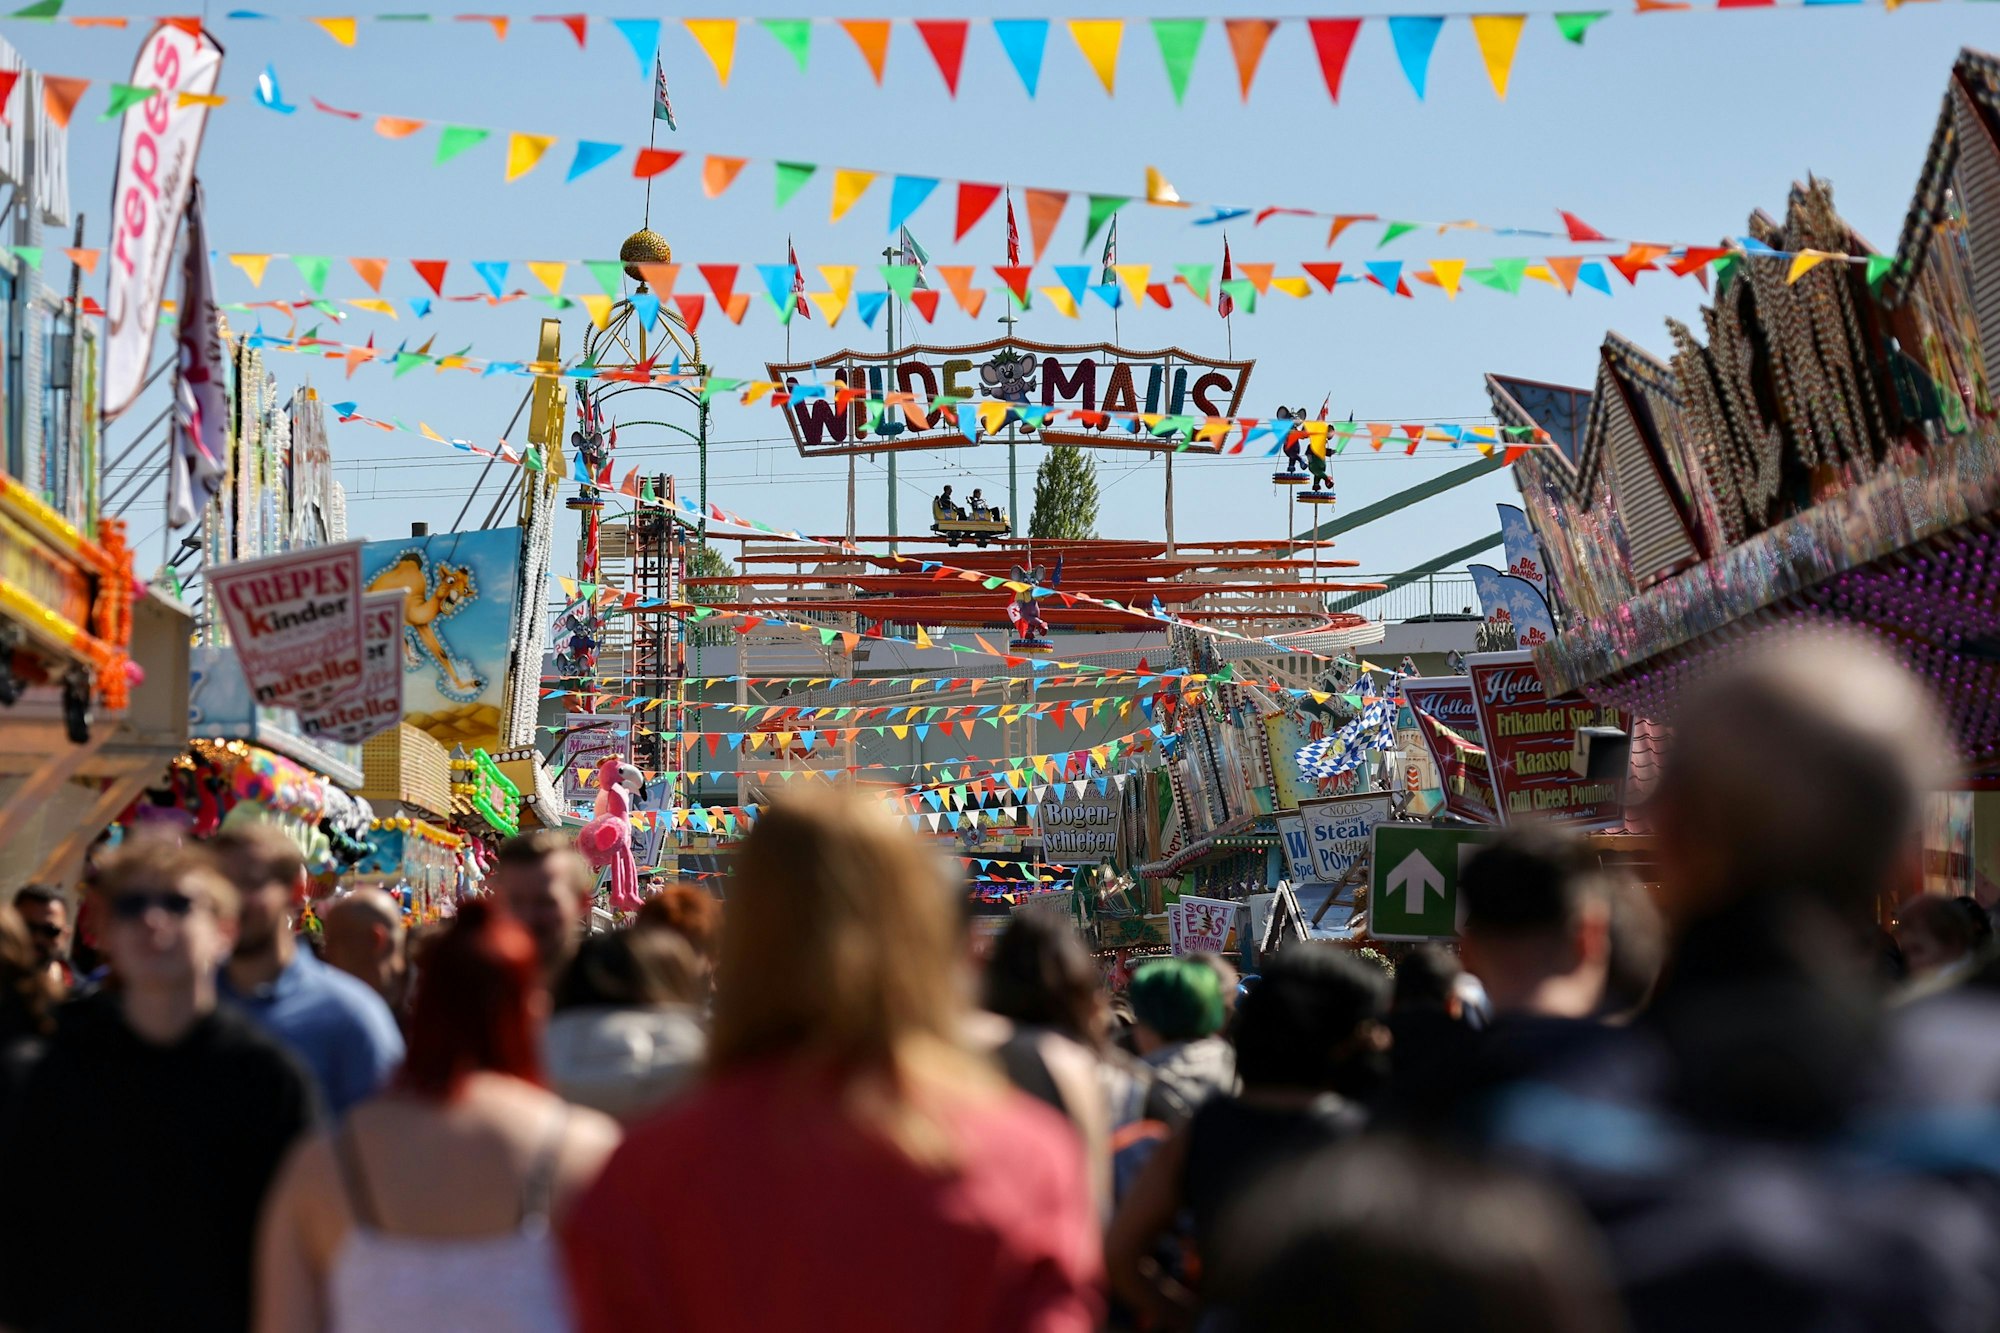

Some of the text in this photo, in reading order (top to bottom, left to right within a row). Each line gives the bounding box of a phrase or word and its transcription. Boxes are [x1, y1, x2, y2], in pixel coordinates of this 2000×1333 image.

[785, 358, 1234, 445] WILDE MAUS
[1510, 564, 1543, 583] BAMBOO
[1520, 557, 1536, 572] BIG
[1496, 607, 1511, 620] BIG
[1529, 626, 1546, 641] BIG
[256, 659, 361, 702] nutella
[303, 698, 399, 733] nutella
[1496, 709, 1566, 738] Frikandel
[1533, 788, 1569, 811] Cheese
[1044, 803, 1117, 828] Bogen-
[1315, 821, 1371, 841] Steak
[1043, 830, 1117, 854] schießen
[1293, 863, 1315, 881] Spe
[1185, 902, 1231, 917] SOFT
